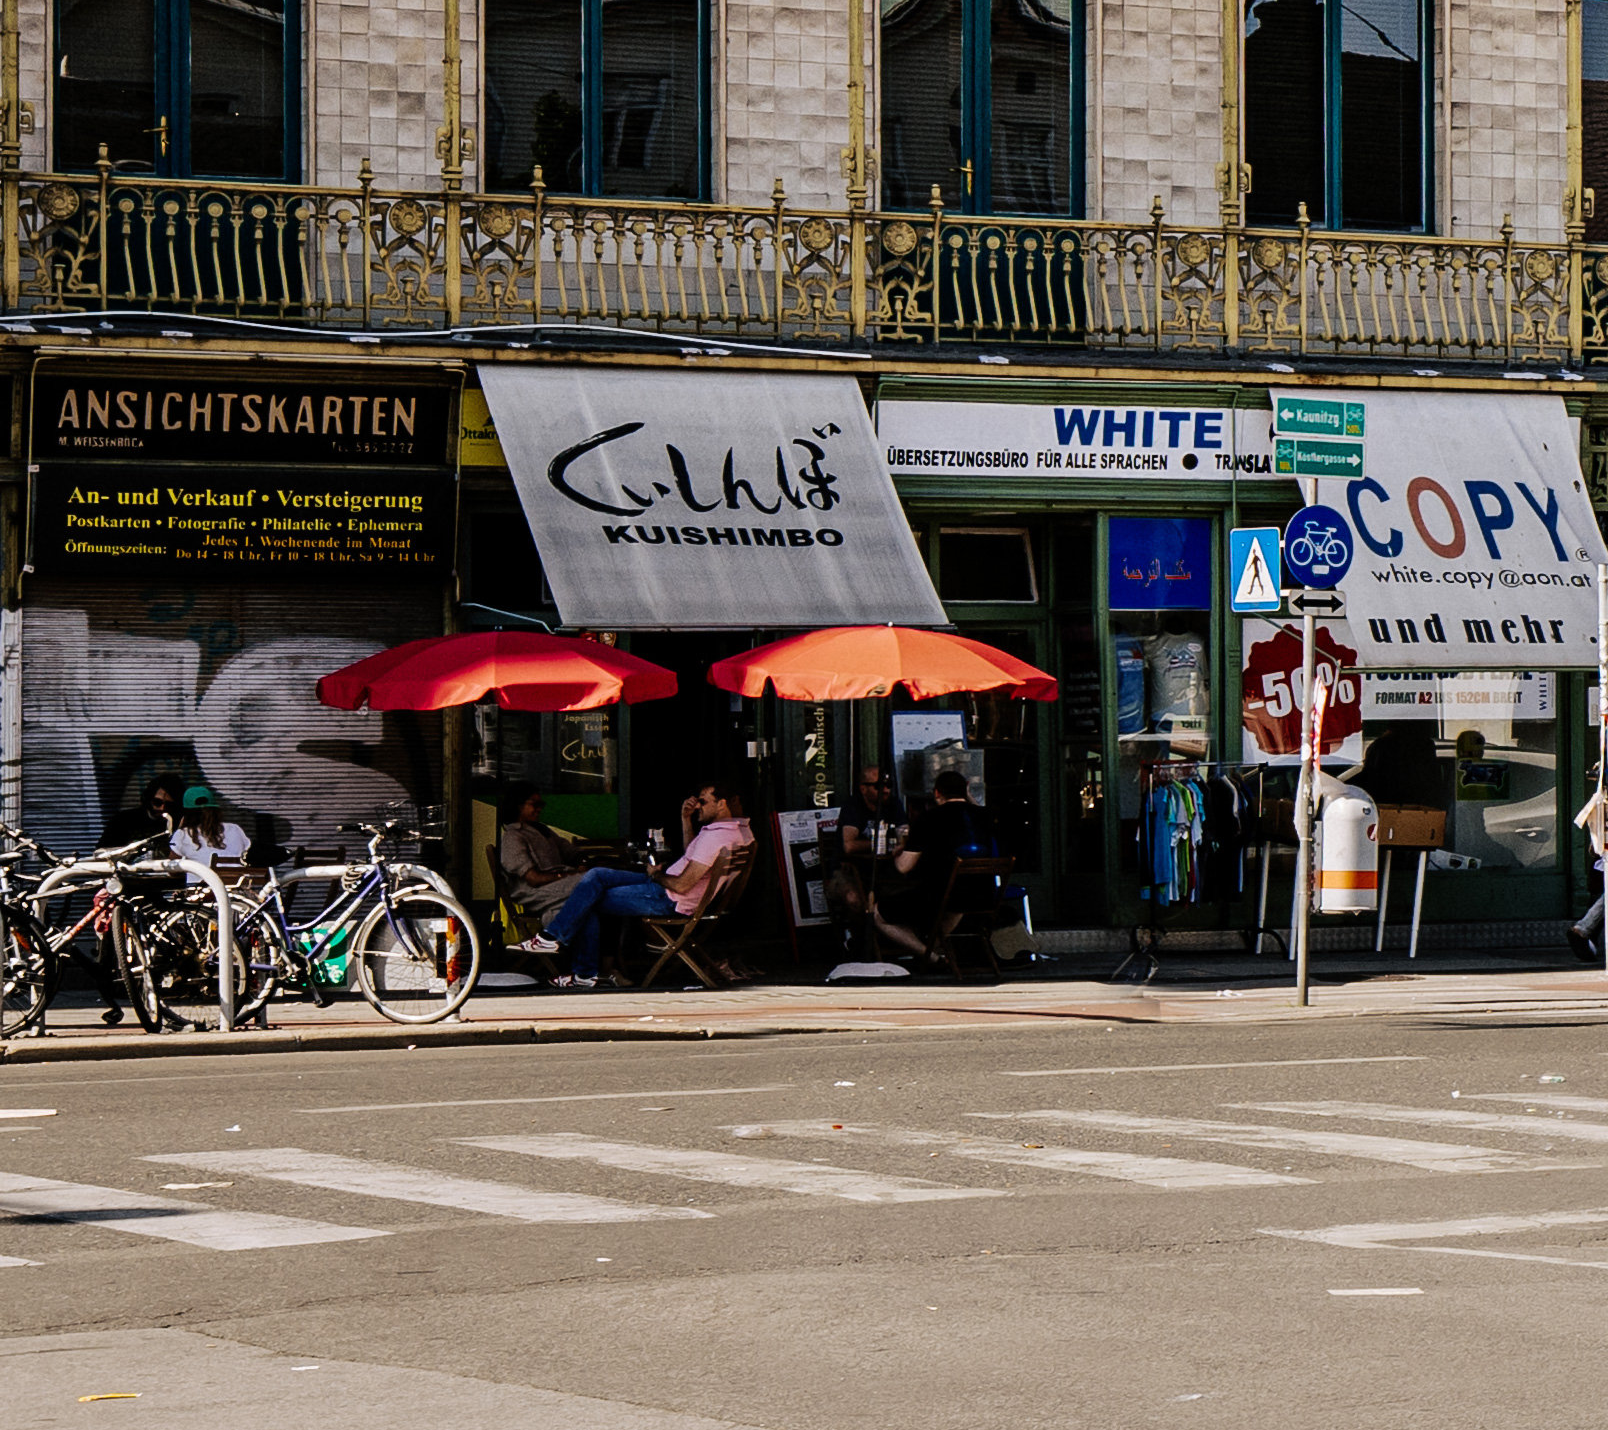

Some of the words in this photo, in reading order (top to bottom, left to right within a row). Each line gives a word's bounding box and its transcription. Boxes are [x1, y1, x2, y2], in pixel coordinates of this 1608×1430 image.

[58, 389, 416, 437] ANSICHTSKARTEN
[1053, 407, 1224, 449] WHITE
[886, 446, 1029, 469] ÜBERSETZUNGSBÜRO
[1036, 449, 1062, 469] FÜR
[1065, 452, 1097, 469] ALLE
[1100, 453, 1168, 471] SPRACHEN
[67, 487, 109, 504] An-
[117, 488, 159, 505] und
[167, 488, 256, 507] Verkauf
[277, 490, 423, 513] Versteigerung
[67, 515, 151, 529] Postkarten
[168, 516, 246, 531] Fotografie
[262, 517, 332, 531] Philatelie
[348, 519, 423, 533] Ephemera
[1346, 476, 1570, 562] COPY
[65, 539, 167, 556] Öffnungszeiten:
[202, 535, 238, 547] Jedes
[260, 536, 340, 548] Wochenende
[346, 537, 363, 548] im
[369, 538, 411, 549] Monat
[601, 524, 844, 548] KUISHIMBO
[1371, 563, 1592, 589] white.copy@aon.at
[1367, 613, 1448, 644] und
[1462, 614, 1565, 644] mehr
[1375, 691, 1417, 705] FORMAT
[1418, 691, 1433, 705] A2
[1455, 692, 1490, 705] 152CM
